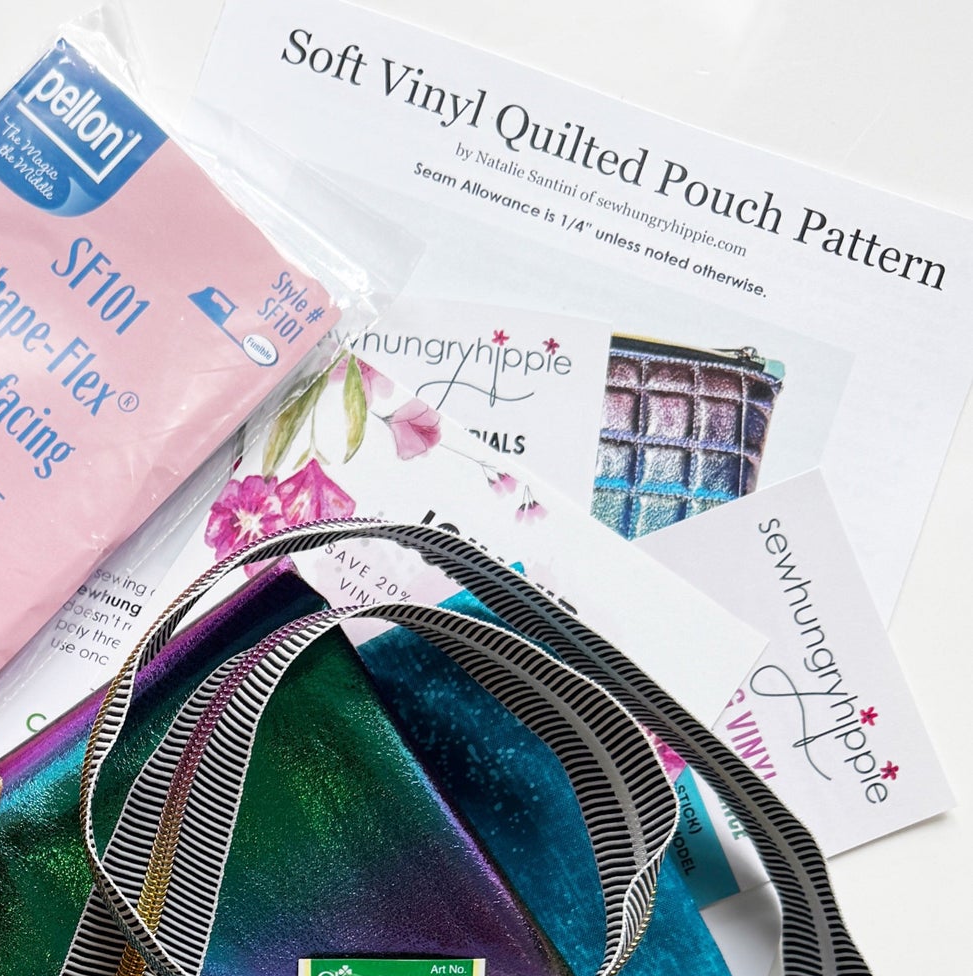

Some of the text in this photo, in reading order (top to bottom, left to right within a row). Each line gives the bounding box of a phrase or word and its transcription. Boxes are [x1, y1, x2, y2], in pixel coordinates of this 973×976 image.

[0, 144, 15, 164] the
[14, 156, 53, 200] Middle
[2, 115, 58, 181] The Magic
[281, 29, 946, 291] Soft Vinyl Quilted Pouch Pattern
[455, 141, 747, 257] by Natalie Santini of sewhungryhippie.com
[413, 162, 767, 298] Seam Allowance is 1/4" unless noted otherwise.
[50, 237, 150, 336] SF101
[271, 271, 325, 325] Style #
[246, 337, 272, 361] Fusible
[257, 297, 304, 345] SF101
[94, 568, 147, 597] sewing
[324, 542, 412, 603] SAVE 20%
[51, 637, 76, 654] use
[756, 517, 890, 804] sewhungryhippie
[430, 965, 467, 974] Art No.
